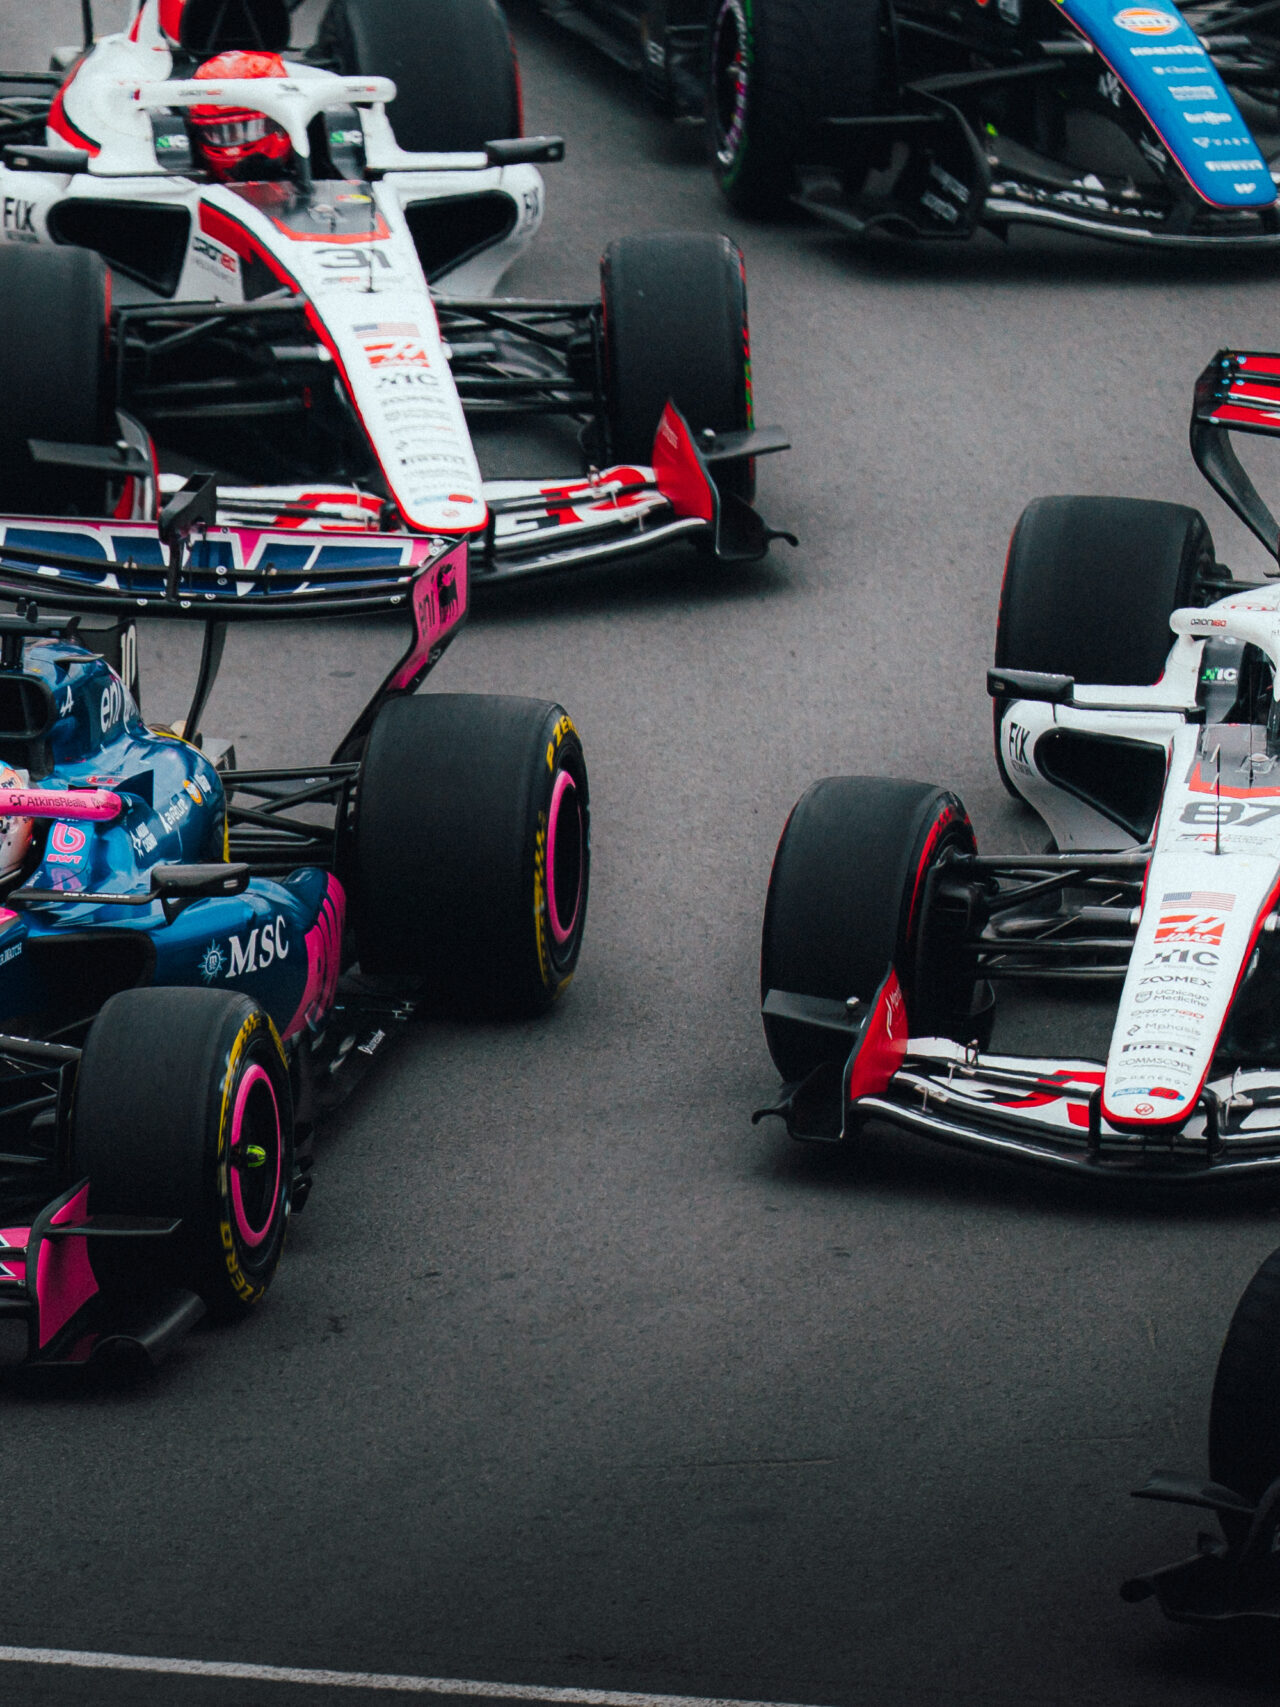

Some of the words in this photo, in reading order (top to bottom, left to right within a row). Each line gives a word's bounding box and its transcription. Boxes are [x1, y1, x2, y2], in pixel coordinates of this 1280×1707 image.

[4, 197, 36, 233] FIX
[313, 248, 392, 269] 31
[1009, 721, 1031, 765] FIX
[1178, 801, 1280, 827] 87
[225, 914, 289, 979] MSC
